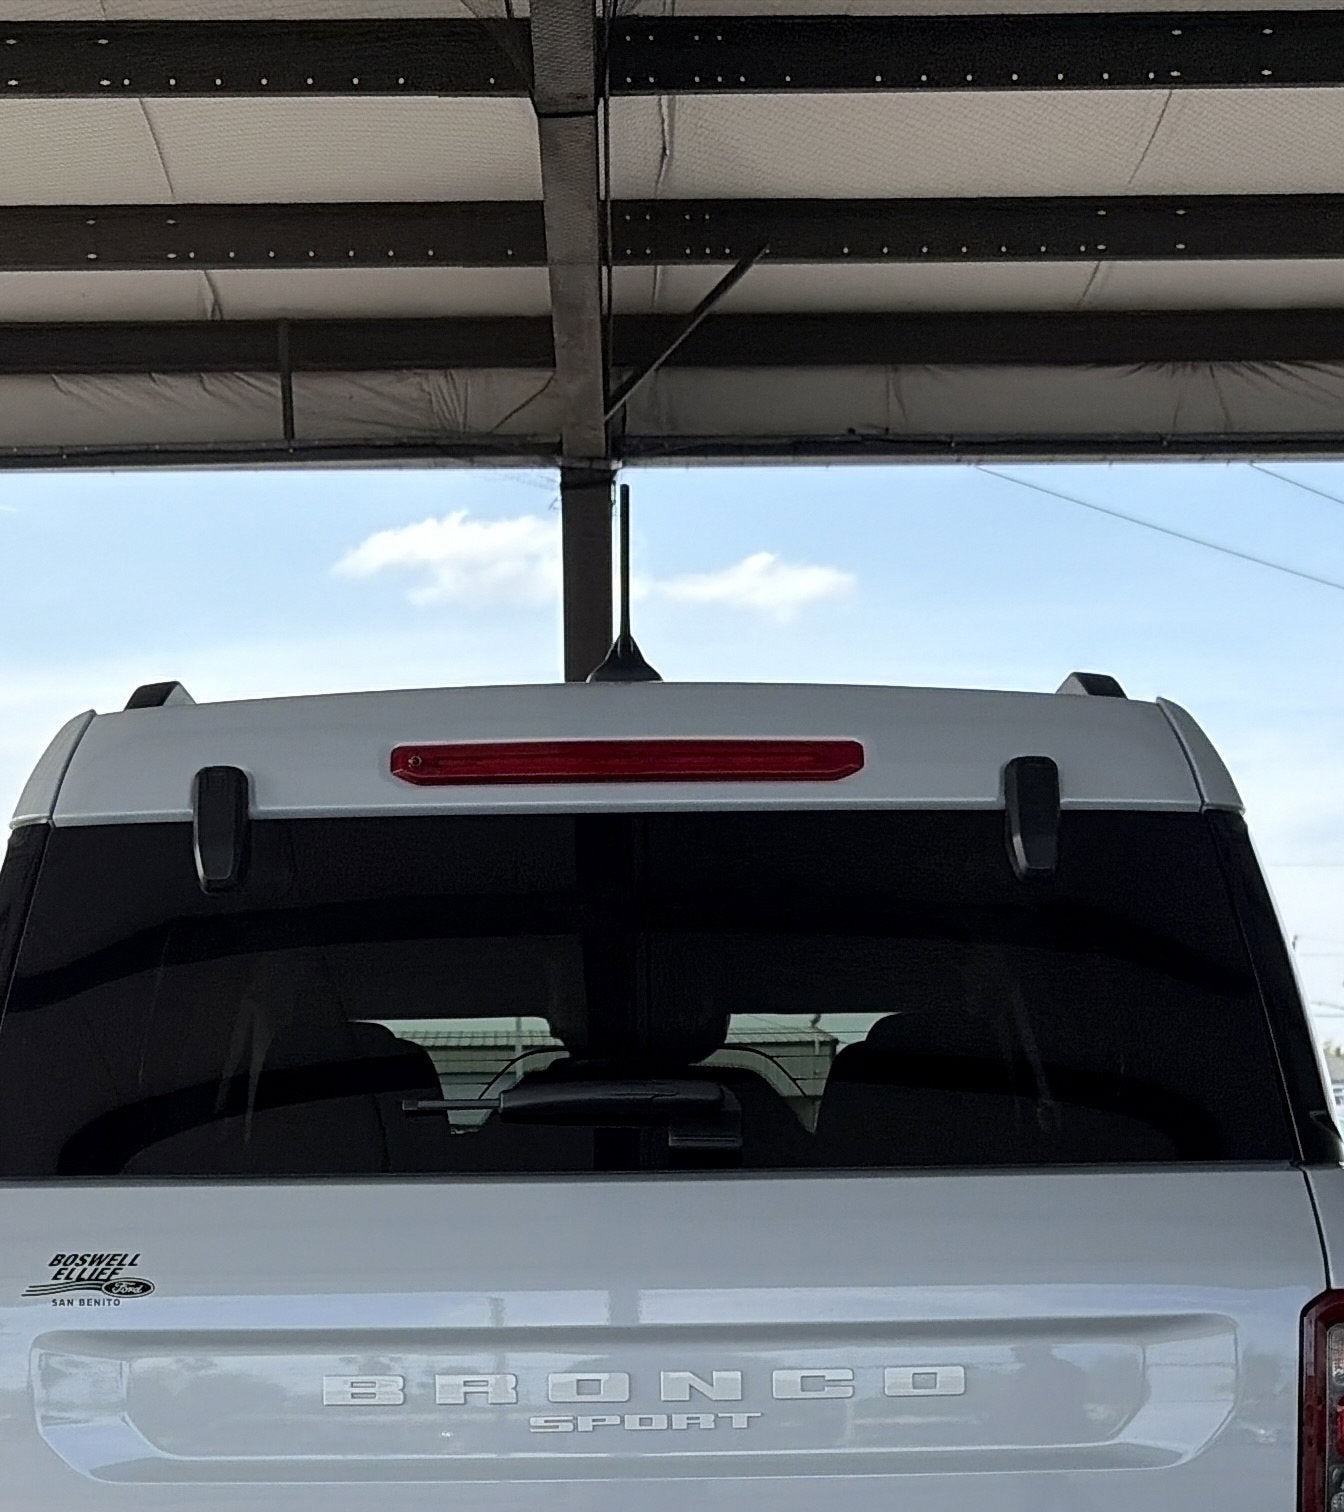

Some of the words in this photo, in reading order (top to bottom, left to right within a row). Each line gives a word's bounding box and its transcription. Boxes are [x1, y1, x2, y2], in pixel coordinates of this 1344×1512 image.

[48, 1253, 141, 1267] BOSWELL
[51, 1267, 124, 1281] ELLIFF
[51, 1298, 74, 1307] SAN
[78, 1298, 121, 1307] BENITO
[322, 1365, 968, 1406] BRONCO
[529, 1411, 763, 1433] SPORT
